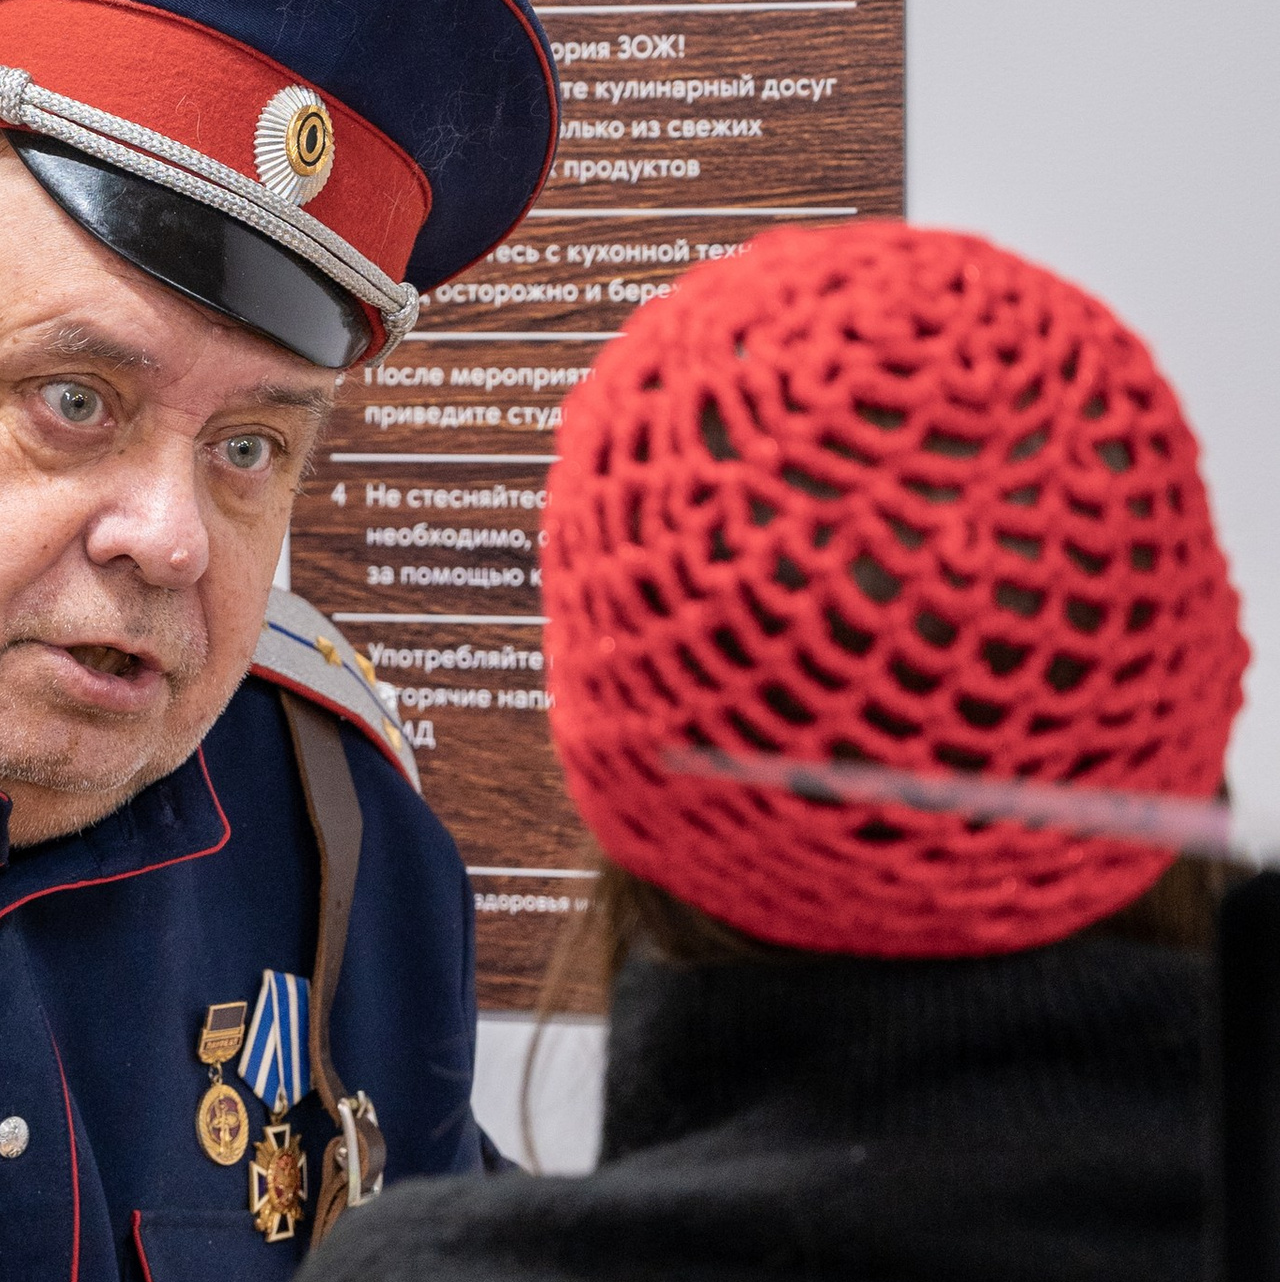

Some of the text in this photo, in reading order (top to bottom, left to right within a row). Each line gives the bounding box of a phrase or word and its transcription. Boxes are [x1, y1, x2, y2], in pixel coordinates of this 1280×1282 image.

[551, 33, 686, 65] ория ЗОЖ!
[595, 74, 755, 104] кулинарный
[761, 78, 837, 102] досуг
[631, 119, 661, 138] из
[667, 118, 763, 138] свежих
[564, 159, 701, 184] продуктов
[545, 244, 561, 263] с
[567, 238, 689, 268] кухонной
[696, 243, 752, 261] техн
[436, 283, 579, 307] осторожно
[585, 284, 601, 302] и
[608, 277, 681, 306] бере
[364, 365, 444, 386] После
[450, 367, 595, 391] мероприят
[365, 405, 567, 431] приведите студ
[331, 482, 552, 509] 4 Не стесняйтес
[366, 522, 532, 551] необходимо,
[367, 565, 395, 585] за
[401, 565, 524, 588] помощью
[368, 642, 544, 674] Употребляйте
[396, 686, 556, 713] орячие напи
